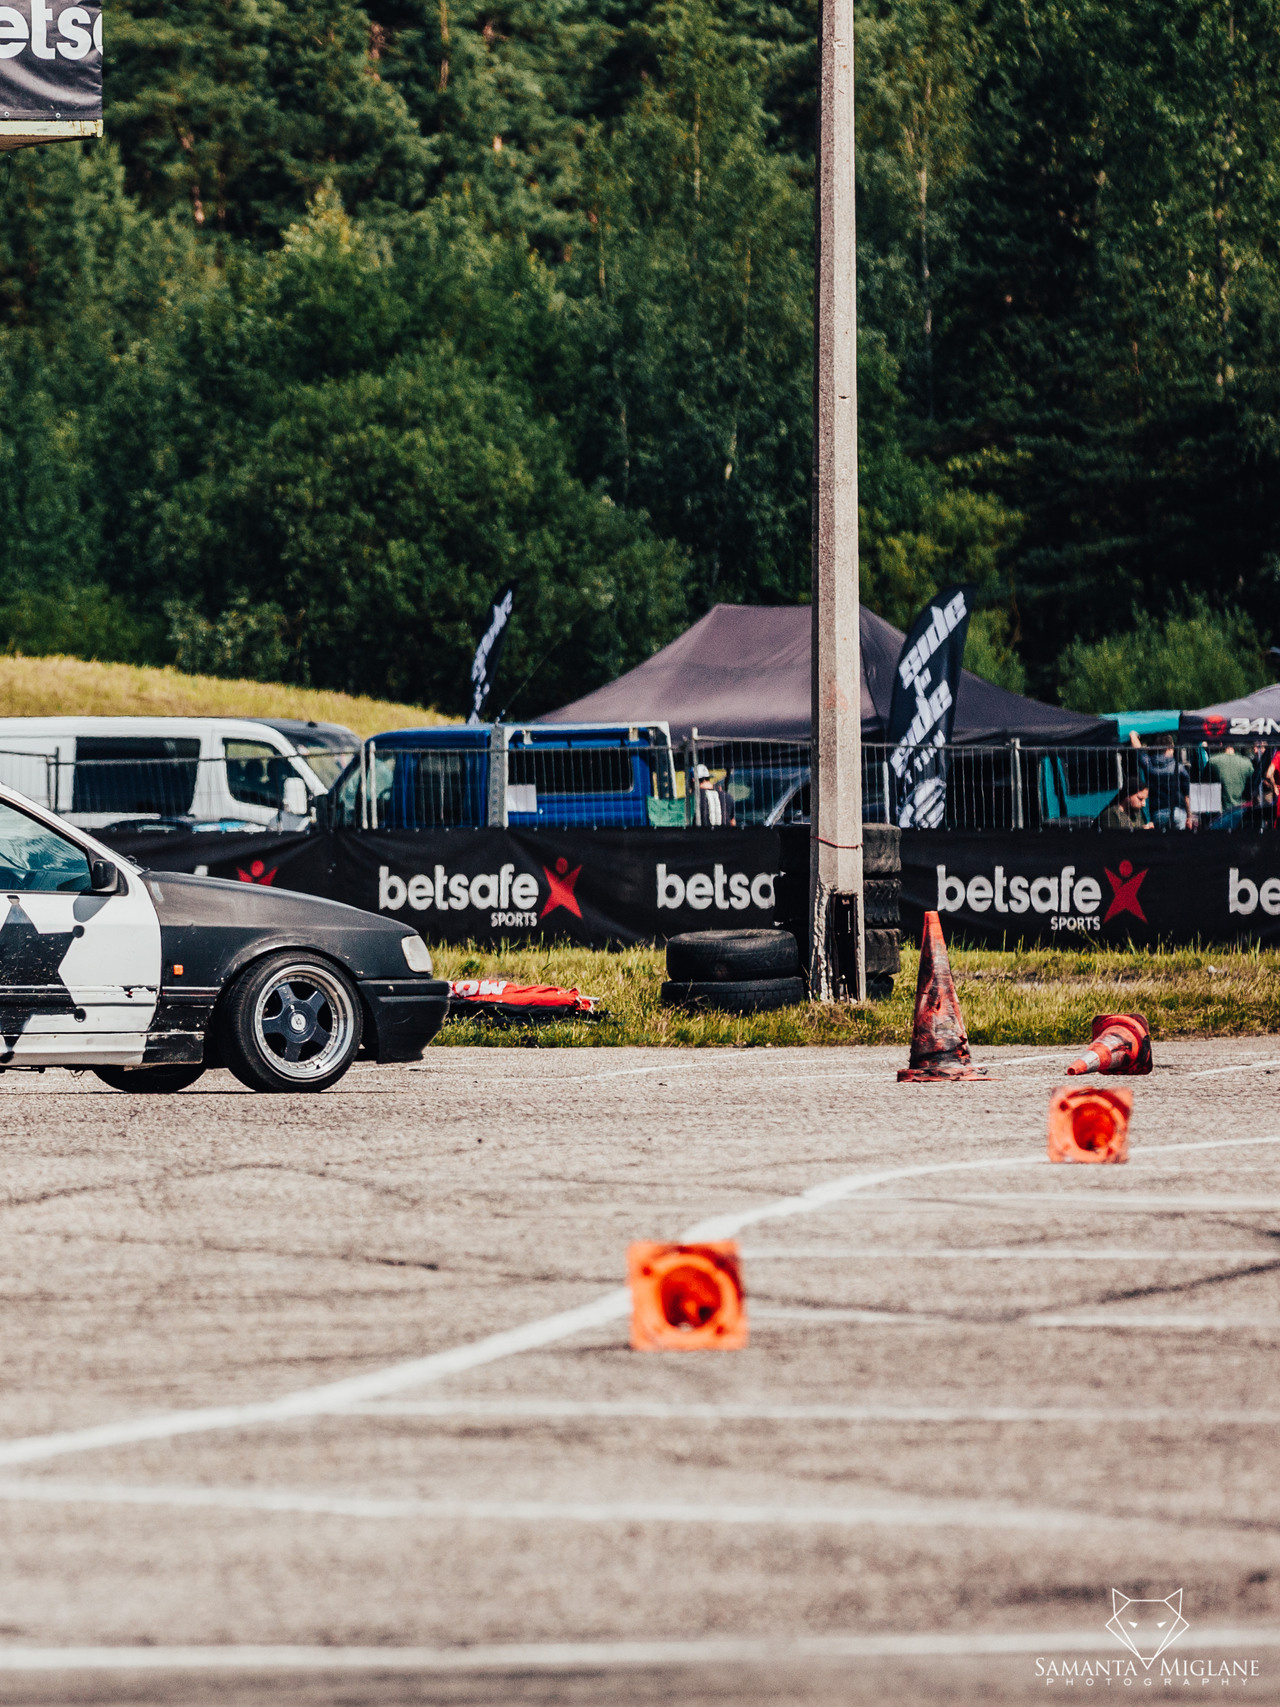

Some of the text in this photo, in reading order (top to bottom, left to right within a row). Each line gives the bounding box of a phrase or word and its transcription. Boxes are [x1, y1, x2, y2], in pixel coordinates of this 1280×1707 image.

[378, 863, 539, 911] betsafe
[936, 864, 1102, 914] betsafe
[490, 911, 538, 928] SPORTS
[1050, 915, 1101, 931] SPORTS
